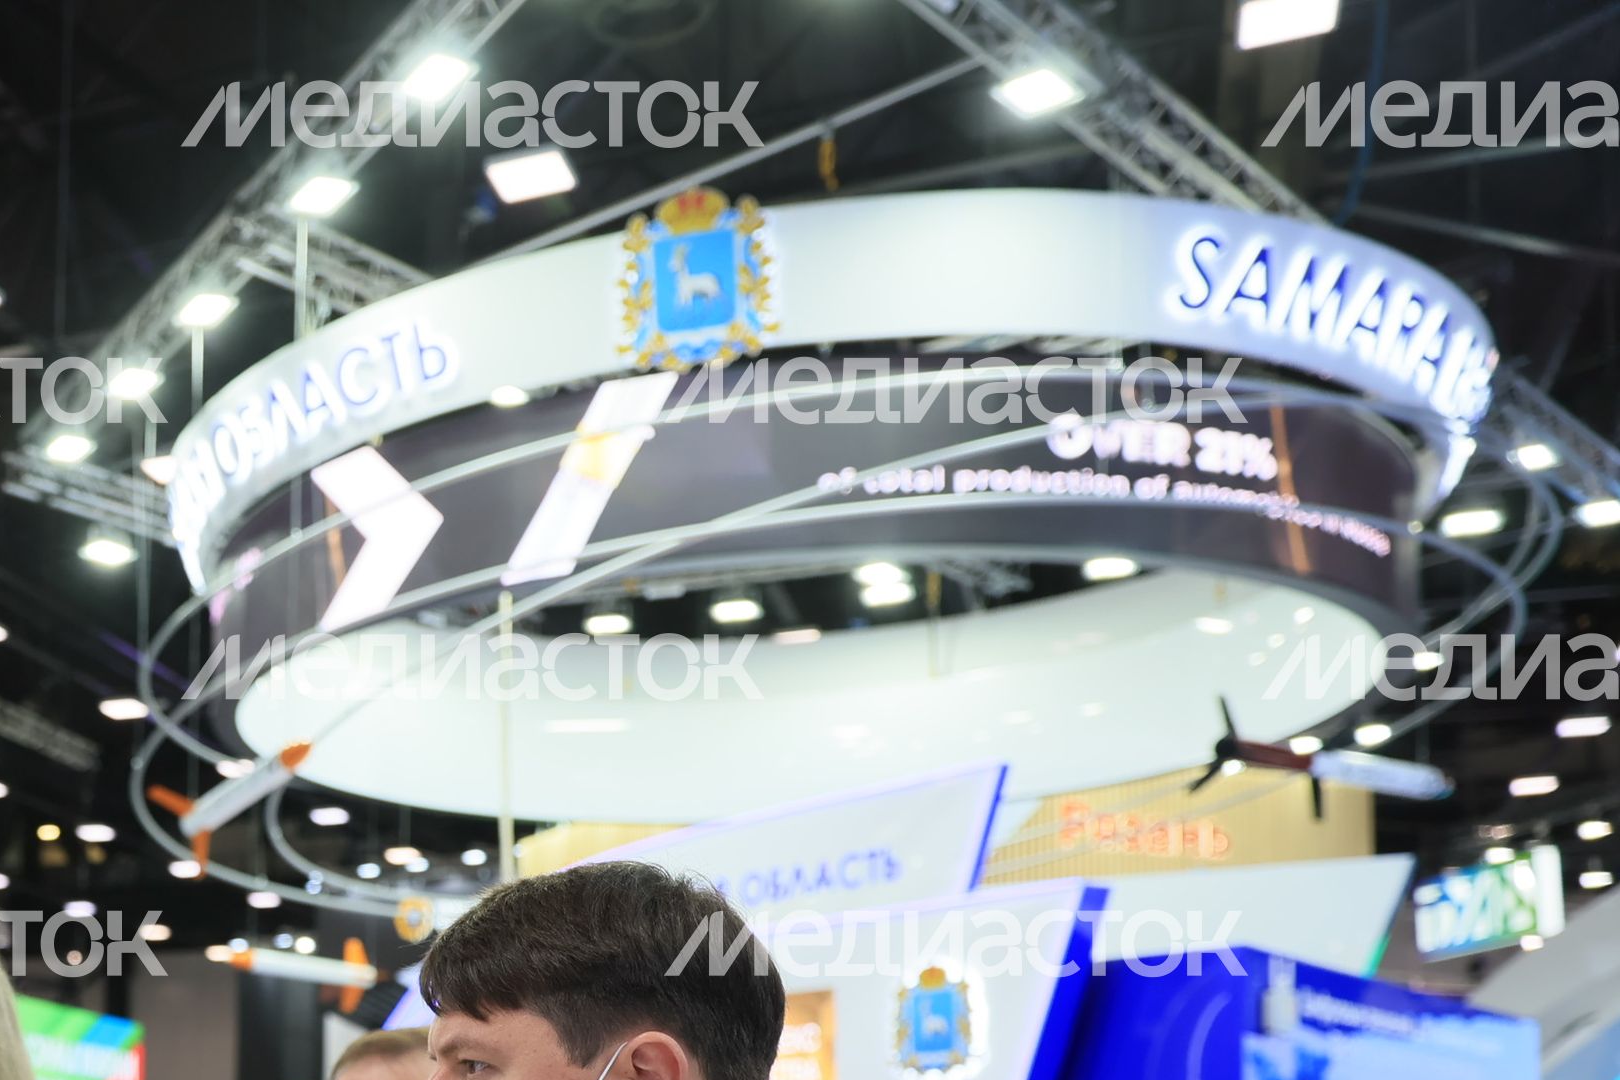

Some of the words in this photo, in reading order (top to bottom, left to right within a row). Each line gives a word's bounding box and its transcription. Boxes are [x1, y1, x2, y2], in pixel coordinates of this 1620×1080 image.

[212, 322, 456, 484] ОБЛАСТЬ
[1047, 414, 1191, 467] OVER
[953, 465, 1130, 499] production
